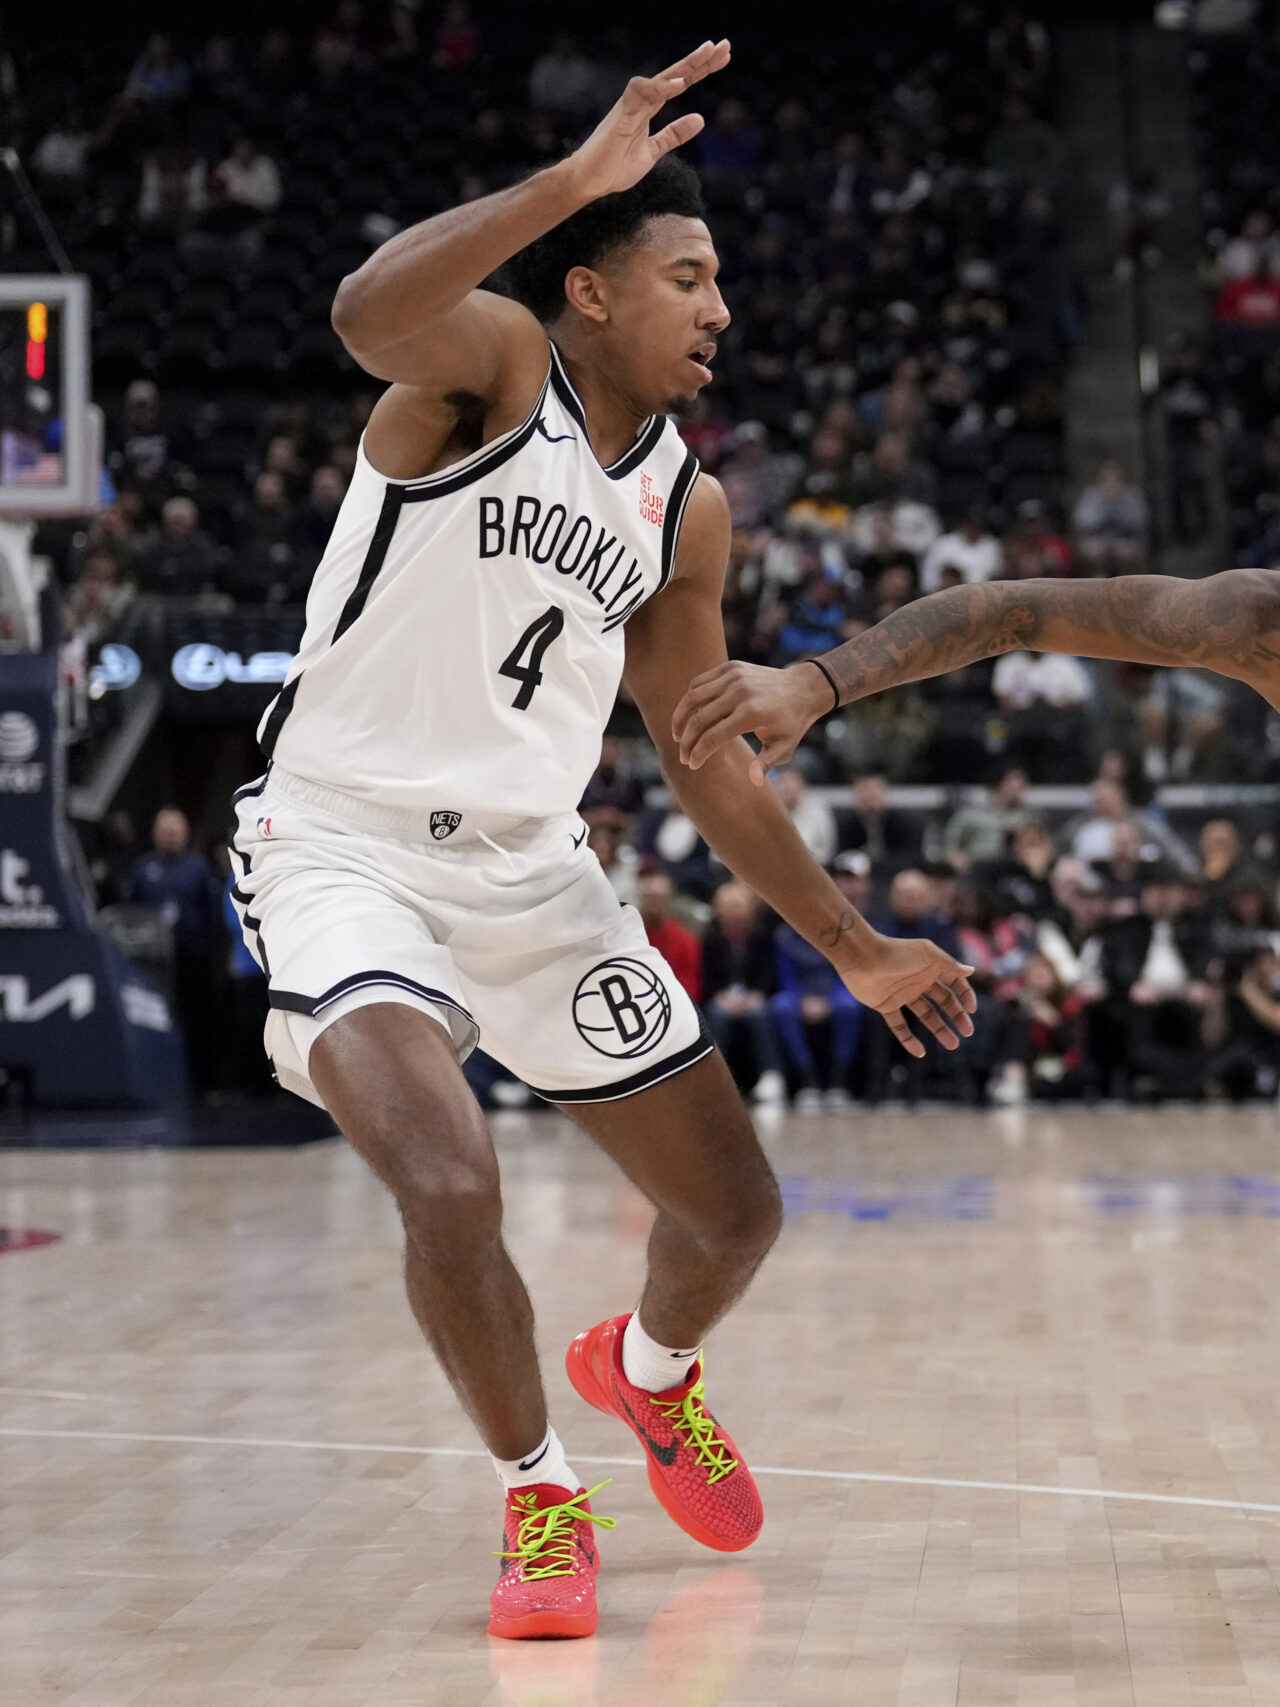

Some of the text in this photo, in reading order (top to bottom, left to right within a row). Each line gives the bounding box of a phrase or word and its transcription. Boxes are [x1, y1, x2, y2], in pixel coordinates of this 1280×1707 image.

[479, 495, 645, 634] BROOKLYN
[498, 605, 564, 711] 4
[431, 812, 461, 826] NETS
[598, 974, 647, 1044] B
